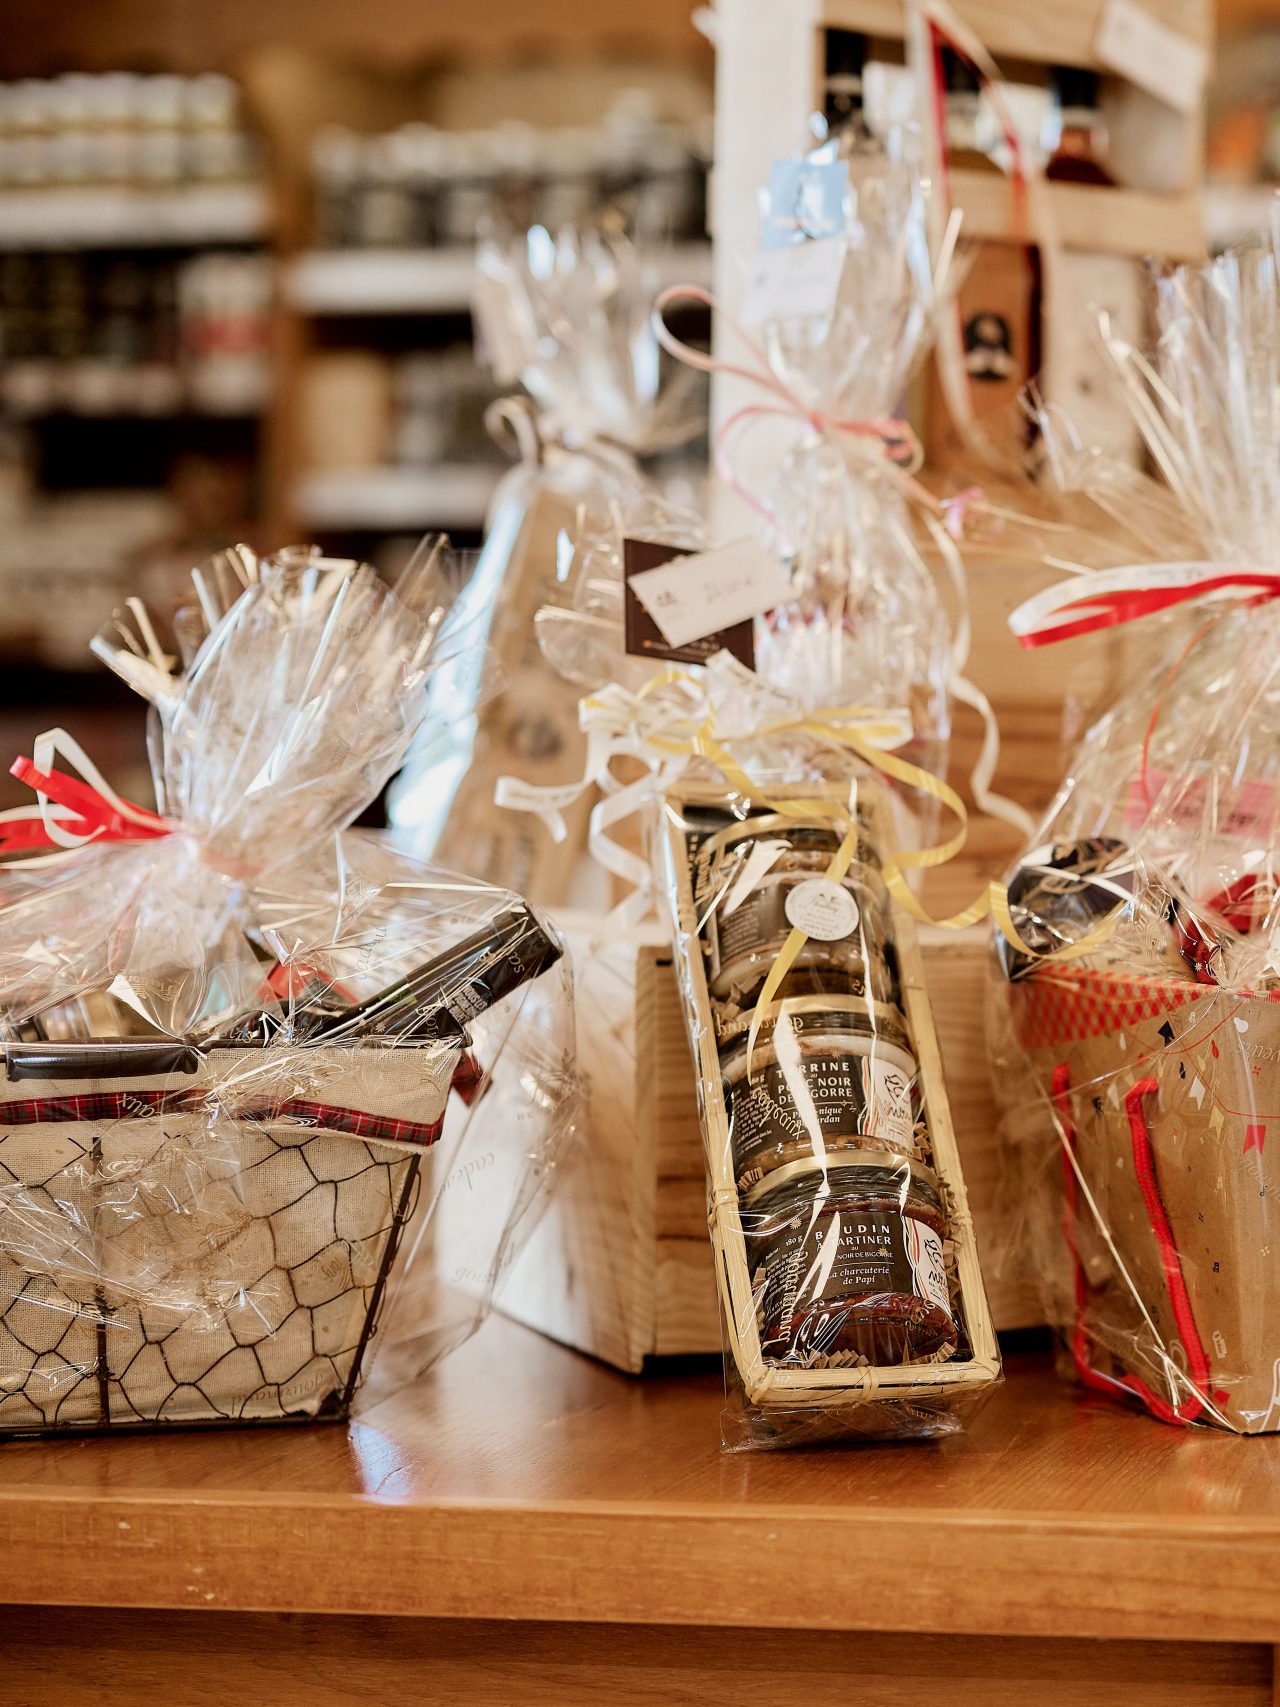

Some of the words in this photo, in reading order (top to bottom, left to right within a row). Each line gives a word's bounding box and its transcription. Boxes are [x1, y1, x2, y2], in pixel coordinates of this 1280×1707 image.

[775, 1062, 850, 1079] TRRINE
[818, 1077, 851, 1087] NOIR
[810, 1087, 853, 1098] GORRE
[815, 1224, 890, 1241] BUDIN
[837, 1235, 892, 1246] ARTINER
[837, 1252, 854, 1260] NOIR
[839, 1266, 890, 1277] charcuterie
[842, 1277, 853, 1286] de
[855, 1275, 876, 1285] Papi
